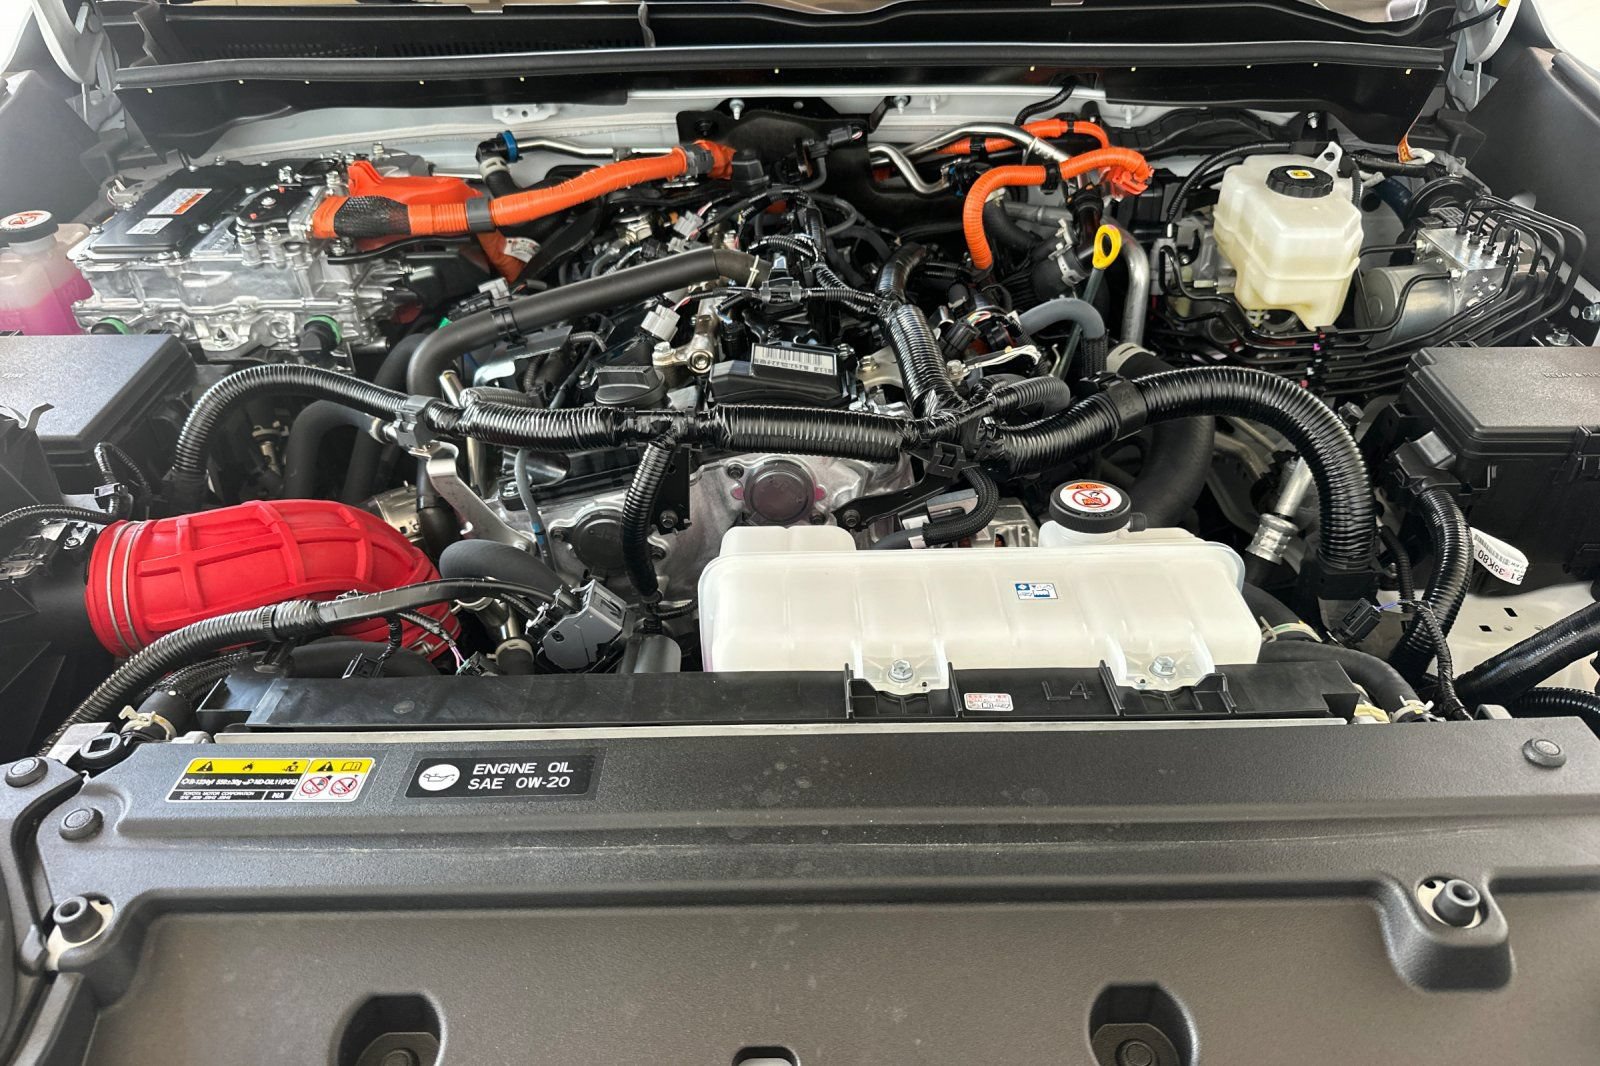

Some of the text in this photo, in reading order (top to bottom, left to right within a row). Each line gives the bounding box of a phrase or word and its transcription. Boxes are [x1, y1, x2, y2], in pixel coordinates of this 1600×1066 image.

[472, 761, 575, 776] ENGINE OIL
[467, 776, 571, 790] SAE 0W-20
